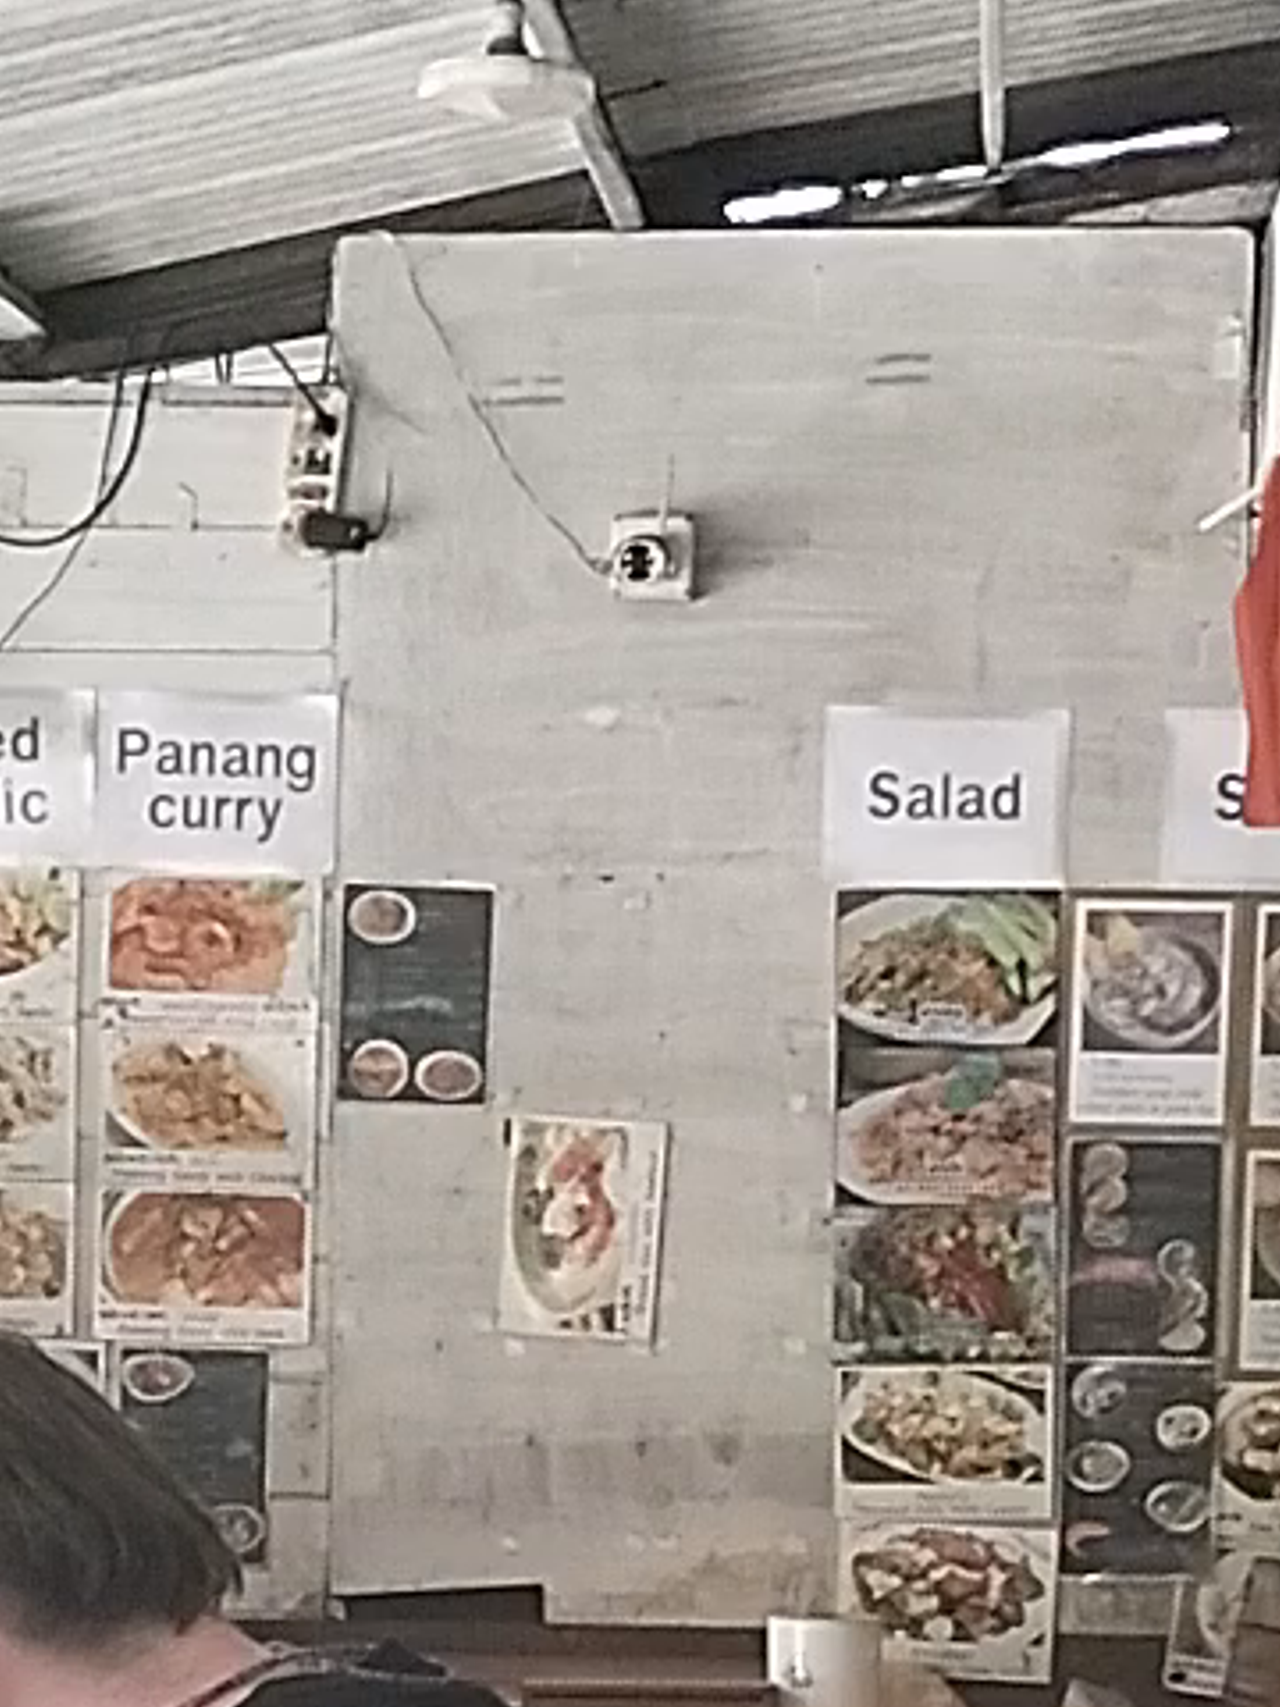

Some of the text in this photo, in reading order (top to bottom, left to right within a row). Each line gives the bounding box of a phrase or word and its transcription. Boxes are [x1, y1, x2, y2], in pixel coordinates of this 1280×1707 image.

[117, 726, 317, 793] Panang
[148, 793, 282, 844] curry
[868, 770, 1021, 820] Salad
